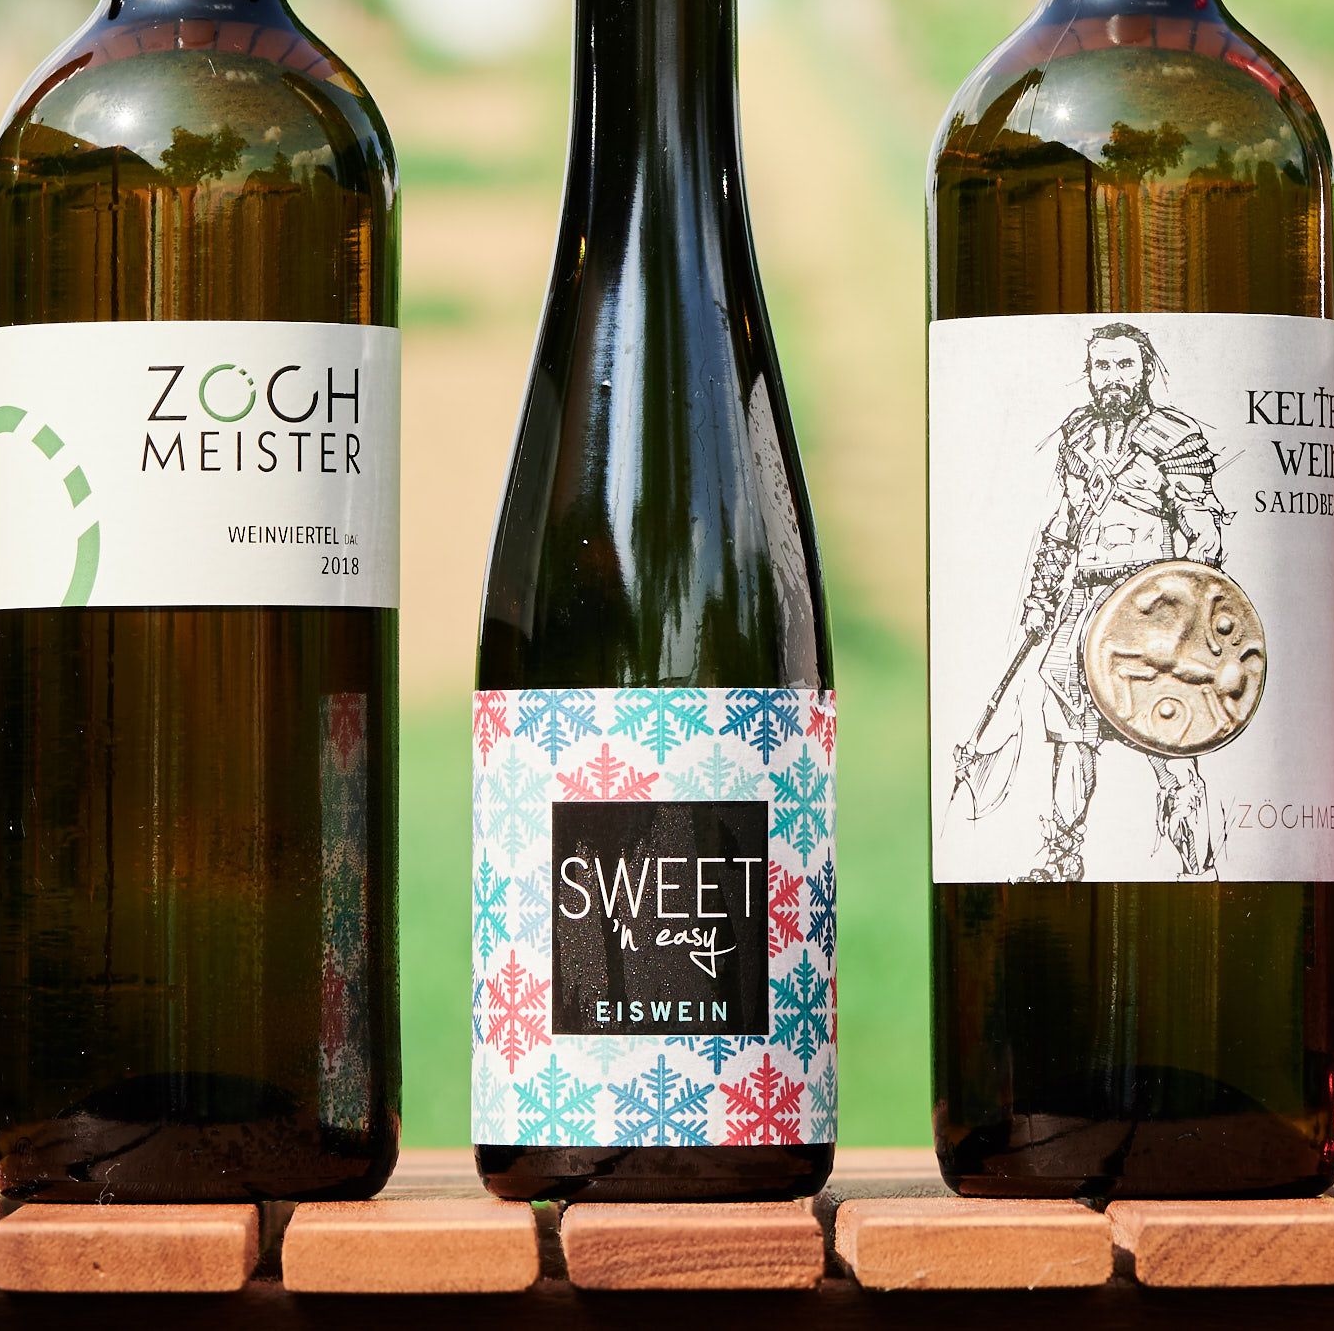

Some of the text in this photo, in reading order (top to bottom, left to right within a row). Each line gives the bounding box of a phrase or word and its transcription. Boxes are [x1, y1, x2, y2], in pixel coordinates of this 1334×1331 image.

[141, 431, 362, 474] MEISTER
[228, 525, 359, 545] WEINVIERTEL DAC
[321, 556, 359, 575] 2018
[558, 856, 763, 920] SWEET
[655, 924, 737, 979] easy
[595, 1000, 728, 1024] EISWEIN
